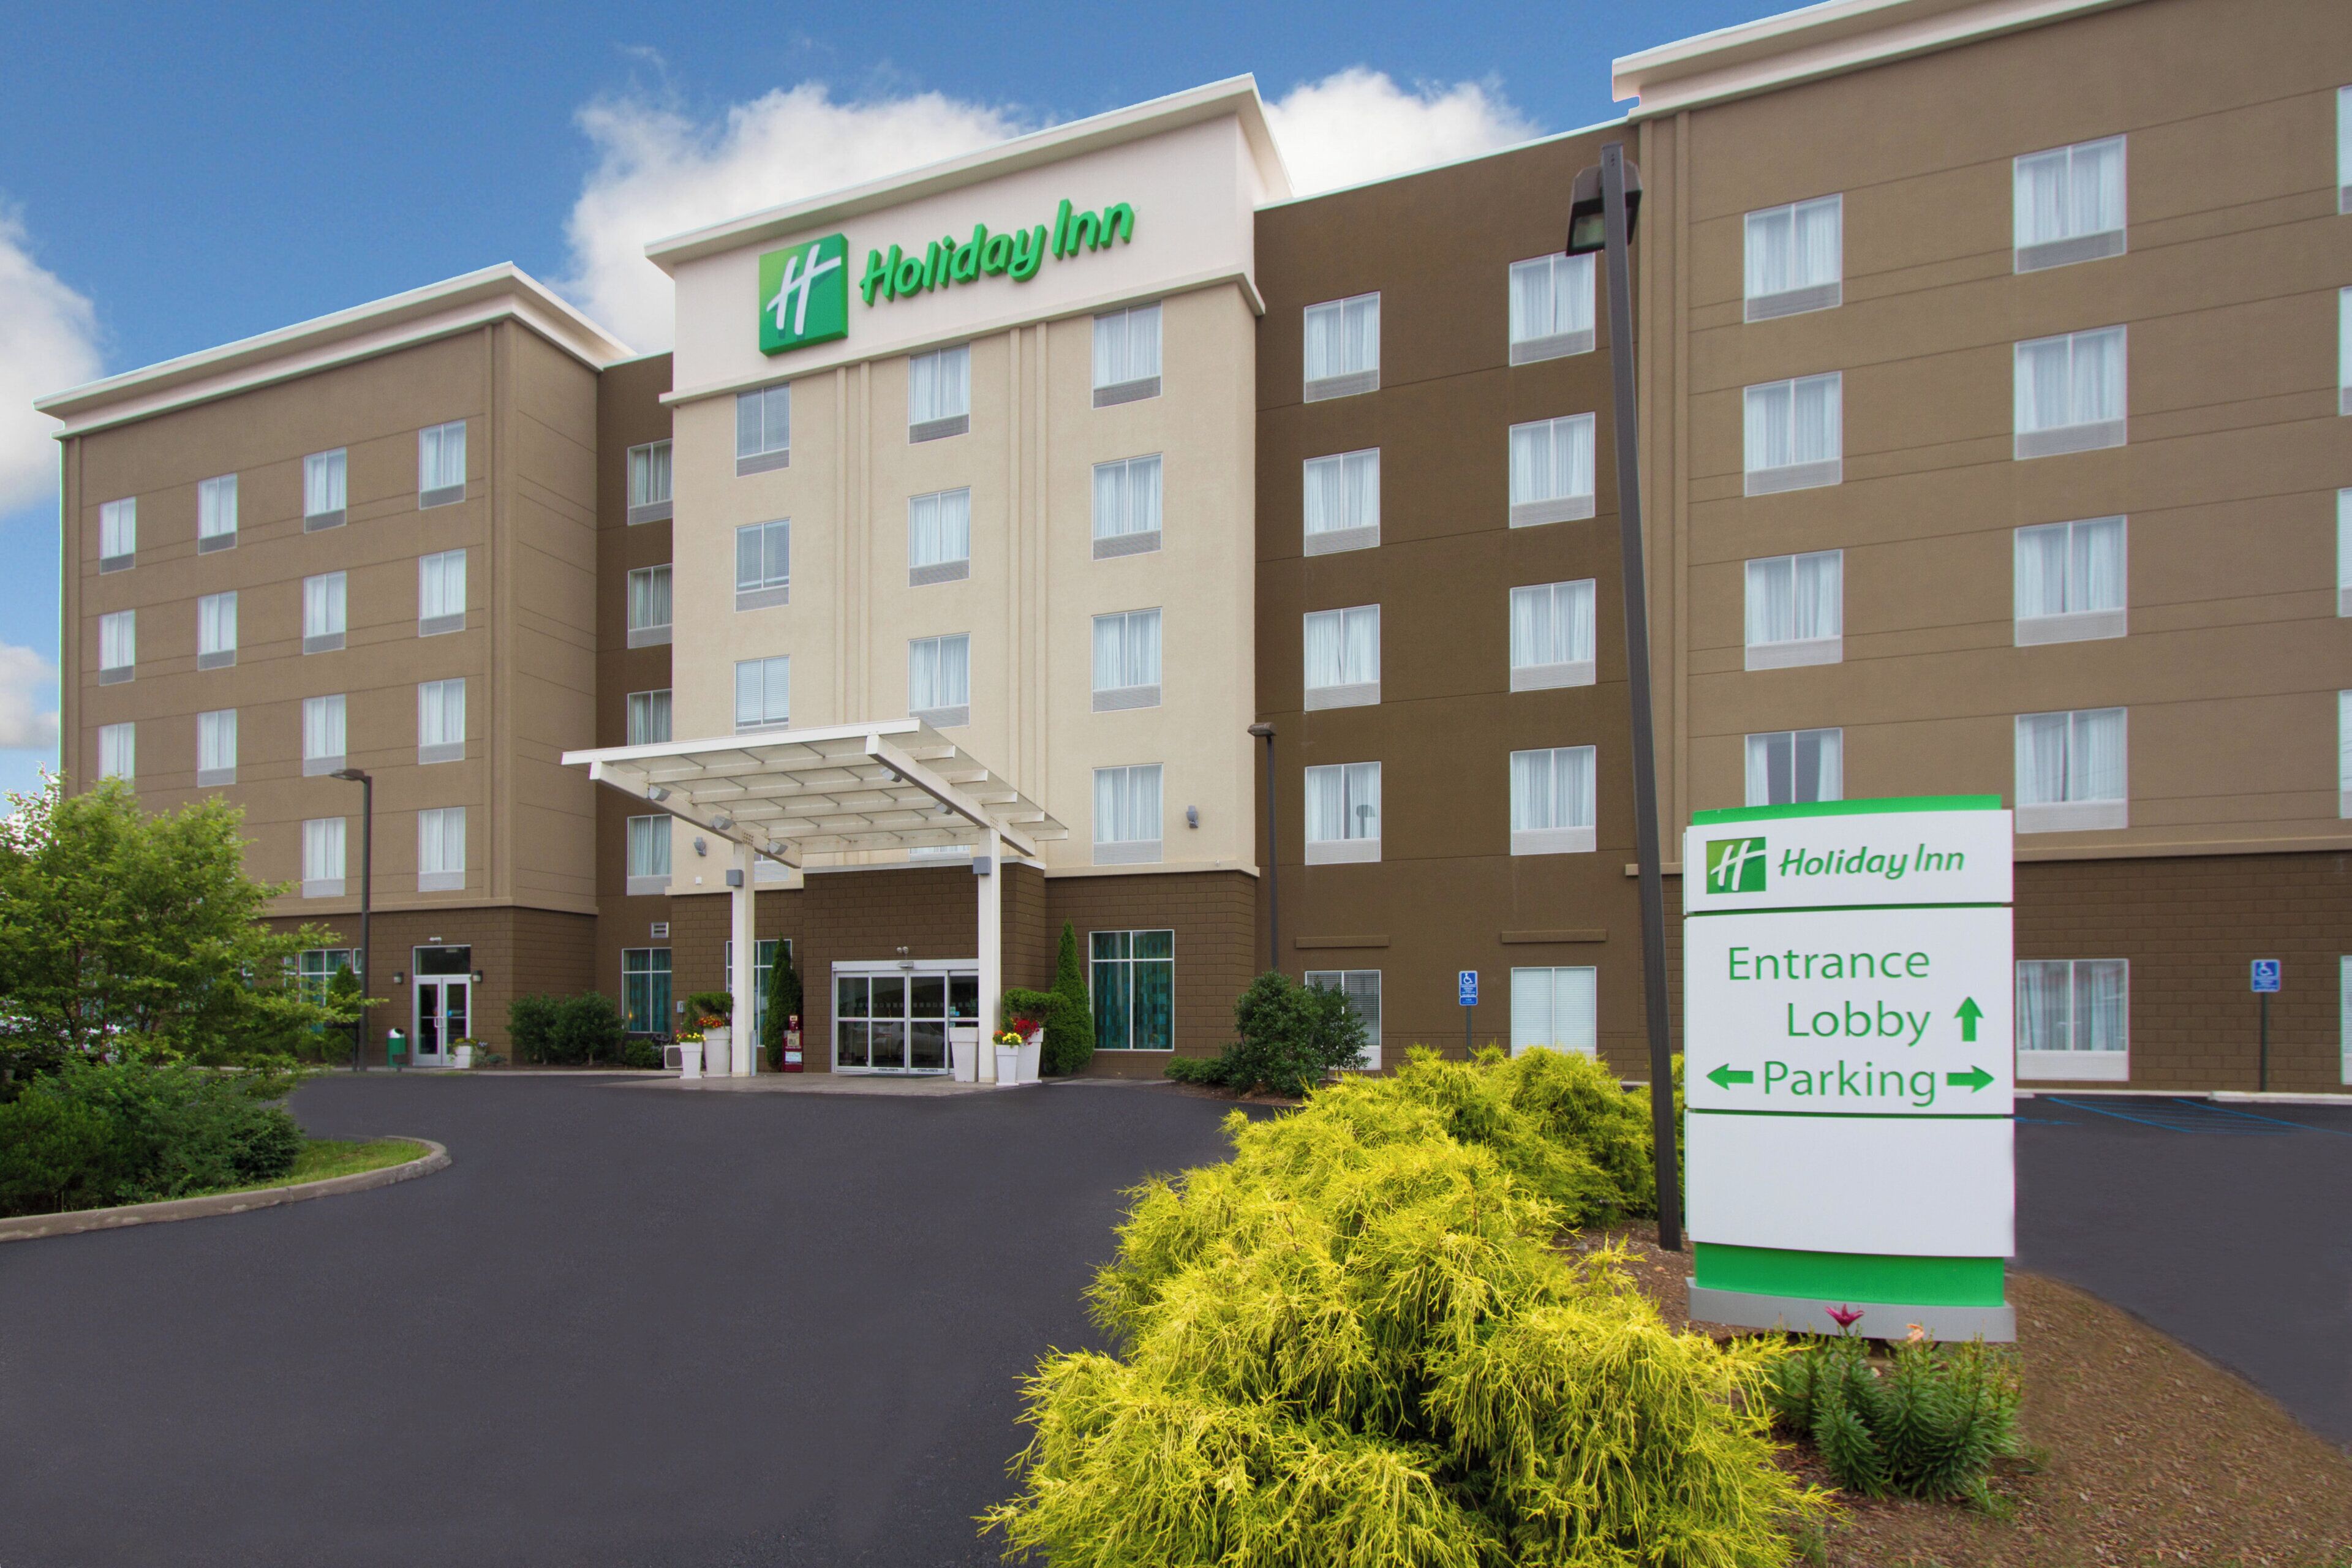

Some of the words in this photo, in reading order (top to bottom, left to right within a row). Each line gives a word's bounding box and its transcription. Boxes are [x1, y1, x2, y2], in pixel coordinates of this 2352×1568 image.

[859, 223, 1047, 306] Holiday
[1051, 198, 1136, 258] Inn
[1779, 846, 1909, 881] Holiday
[1913, 843, 1966, 872] Inn
[1728, 946, 1931, 981] Entrance
[1787, 1001, 1931, 1047] Lobby
[1764, 1060, 1936, 1107] Parking
